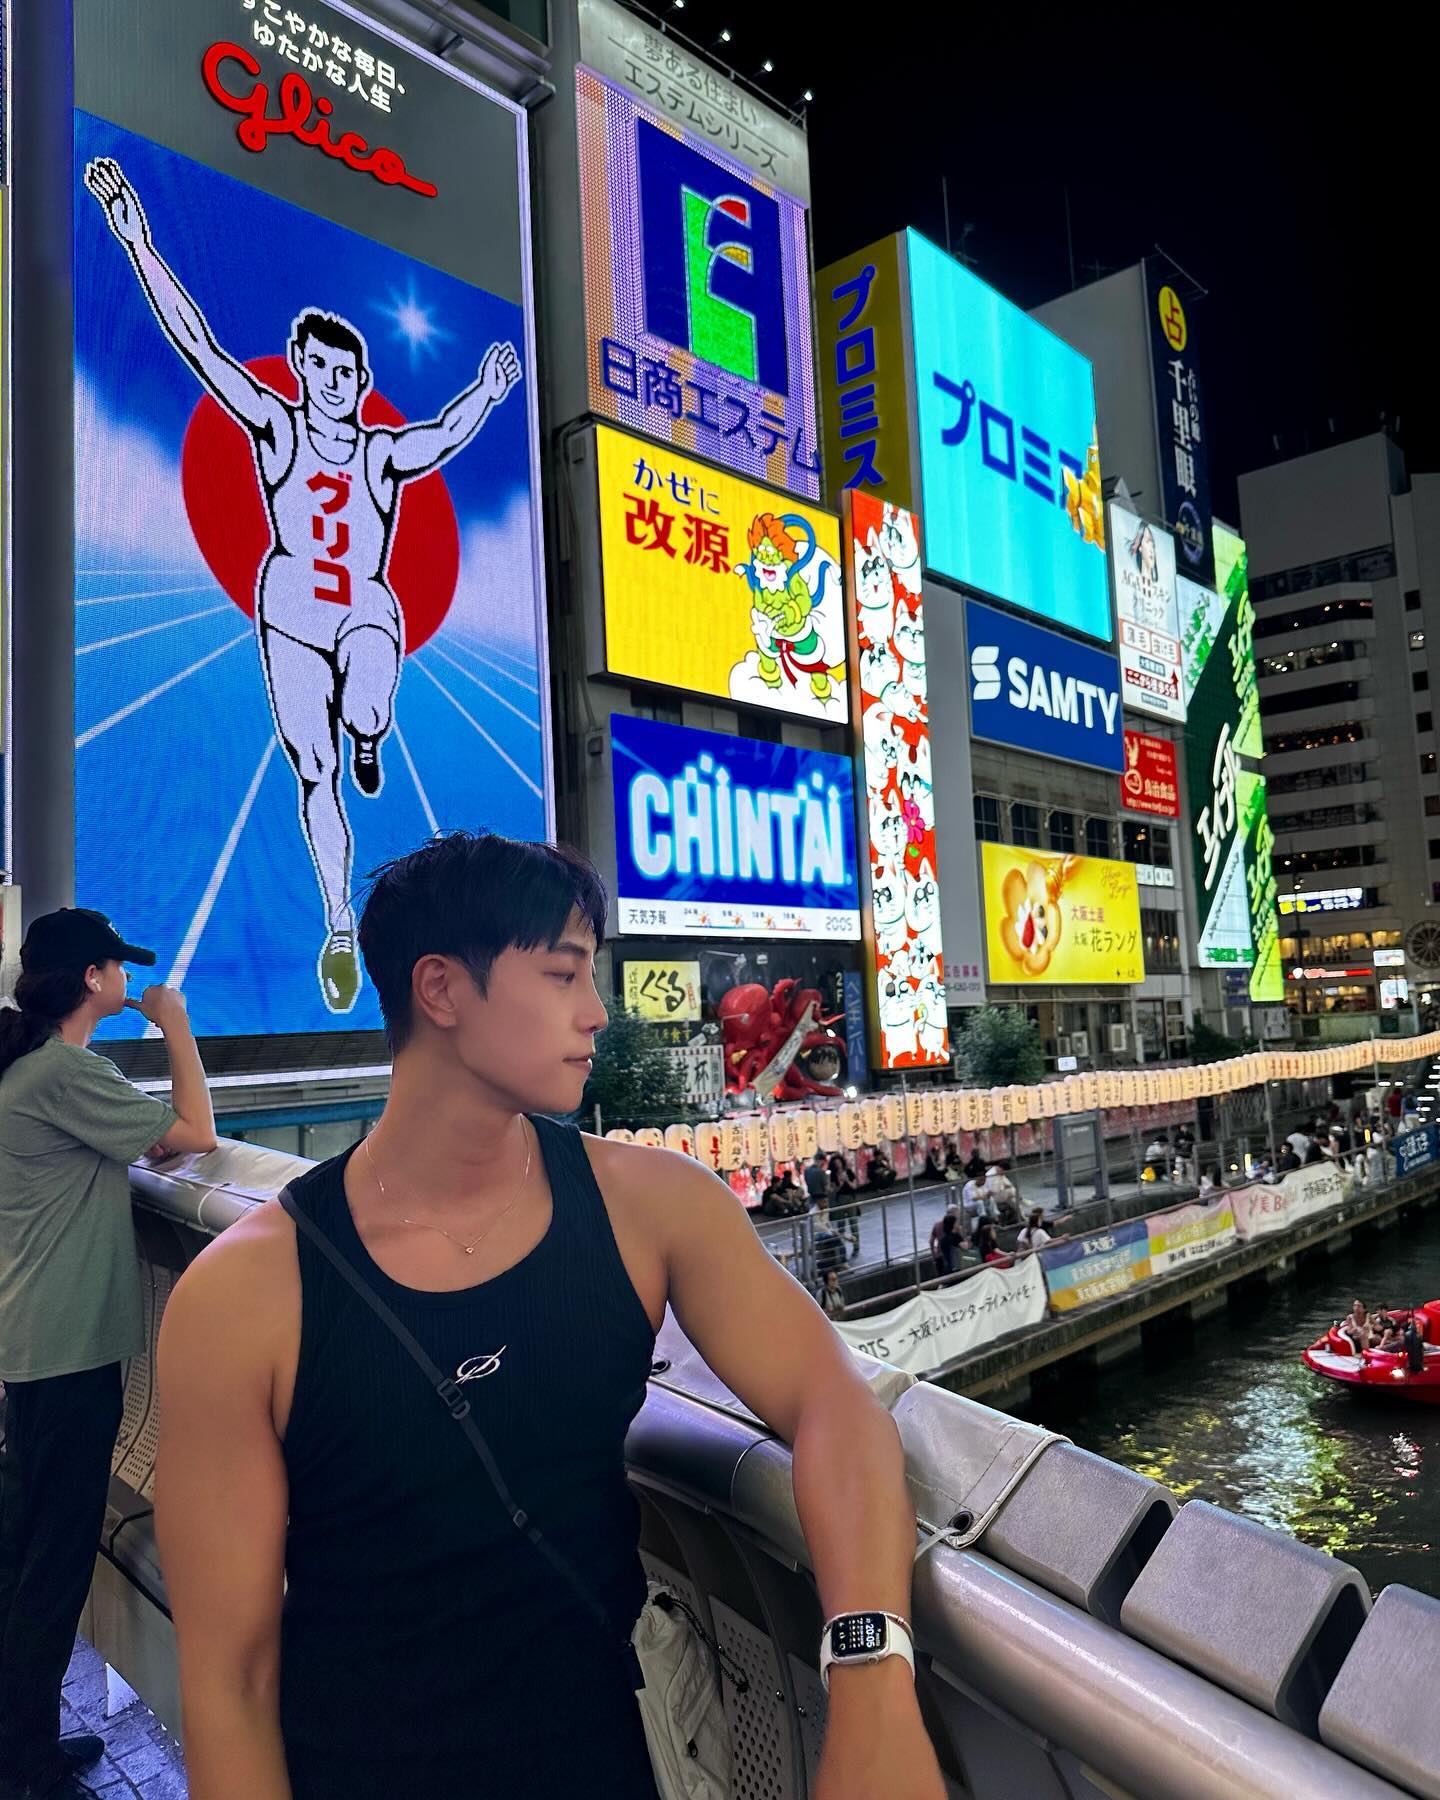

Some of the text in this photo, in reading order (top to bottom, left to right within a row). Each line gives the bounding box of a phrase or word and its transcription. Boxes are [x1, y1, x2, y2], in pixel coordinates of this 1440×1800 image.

[253, 20, 393, 114] ゆたかな人生
[202, 42, 438, 198] Glico
[602, 336, 822, 473] 日商エステム
[832, 264, 888, 490] プロミス
[633, 457, 720, 515] かぜに
[306, 471, 352, 606] グリコ
[623, 492, 731, 574] 改源
[1007, 656, 1119, 735] SAMTY
[640, 970, 686, 1013] くくる
[865, 1624, 875, 1648] 20:05
